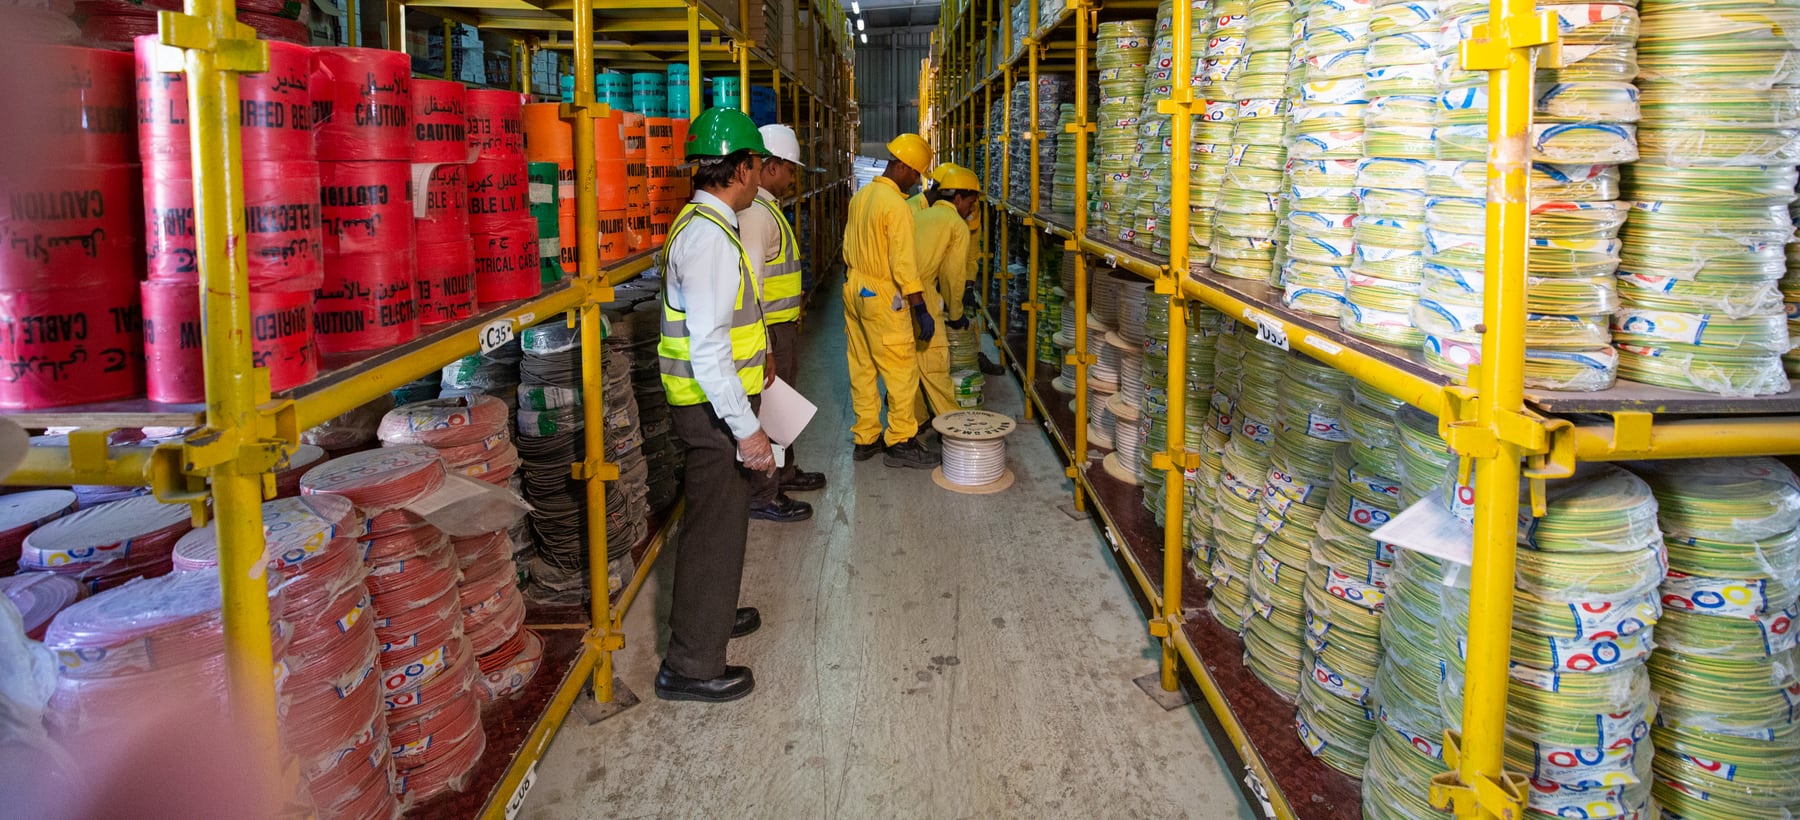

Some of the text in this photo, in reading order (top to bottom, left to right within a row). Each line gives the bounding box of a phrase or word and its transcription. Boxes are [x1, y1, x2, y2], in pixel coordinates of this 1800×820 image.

[416, 123, 465, 142] CAUTION
[22, 312, 88, 345] CABLE
[255, 306, 307, 343] BURIED
[487, 325, 506, 348] C35
